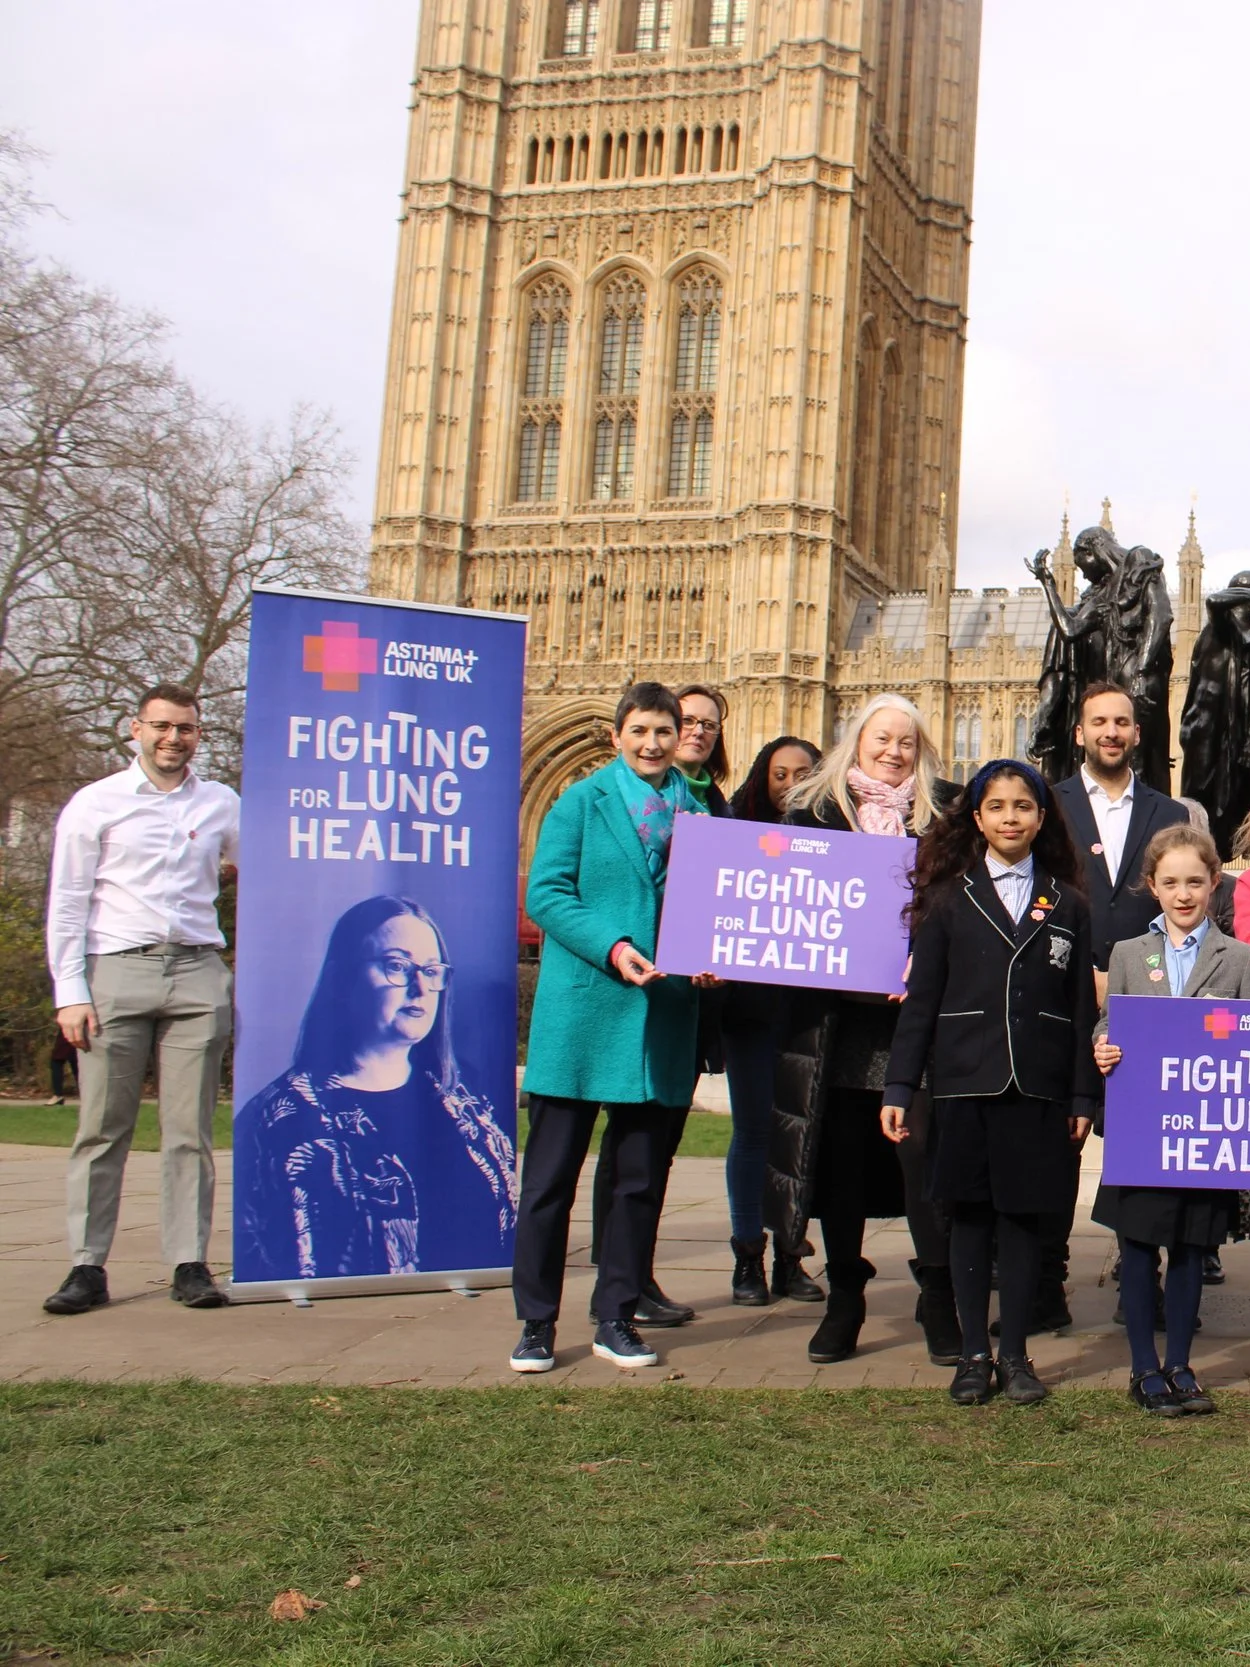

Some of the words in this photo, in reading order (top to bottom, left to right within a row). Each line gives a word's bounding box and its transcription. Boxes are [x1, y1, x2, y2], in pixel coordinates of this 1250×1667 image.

[384, 641, 479, 666] ASTHMA+
[383, 659, 438, 681] LUNG
[445, 665, 473, 684] UK
[288, 711, 490, 770] FIGHTING
[289, 788, 332, 809] FOR
[338, 769, 462, 816] LUNG
[289, 816, 471, 867] HEALTH
[790, 844, 813, 853] LUNG
[816, 846, 828, 854] UK
[791, 838, 831, 849] ASTHMA+
[715, 867, 867, 909] FIGHTING
[714, 916, 745, 931] FOR
[749, 905, 843, 940] LUNG
[711, 934, 848, 976] HEALTH
[1162, 1114, 1195, 1130] FOR
